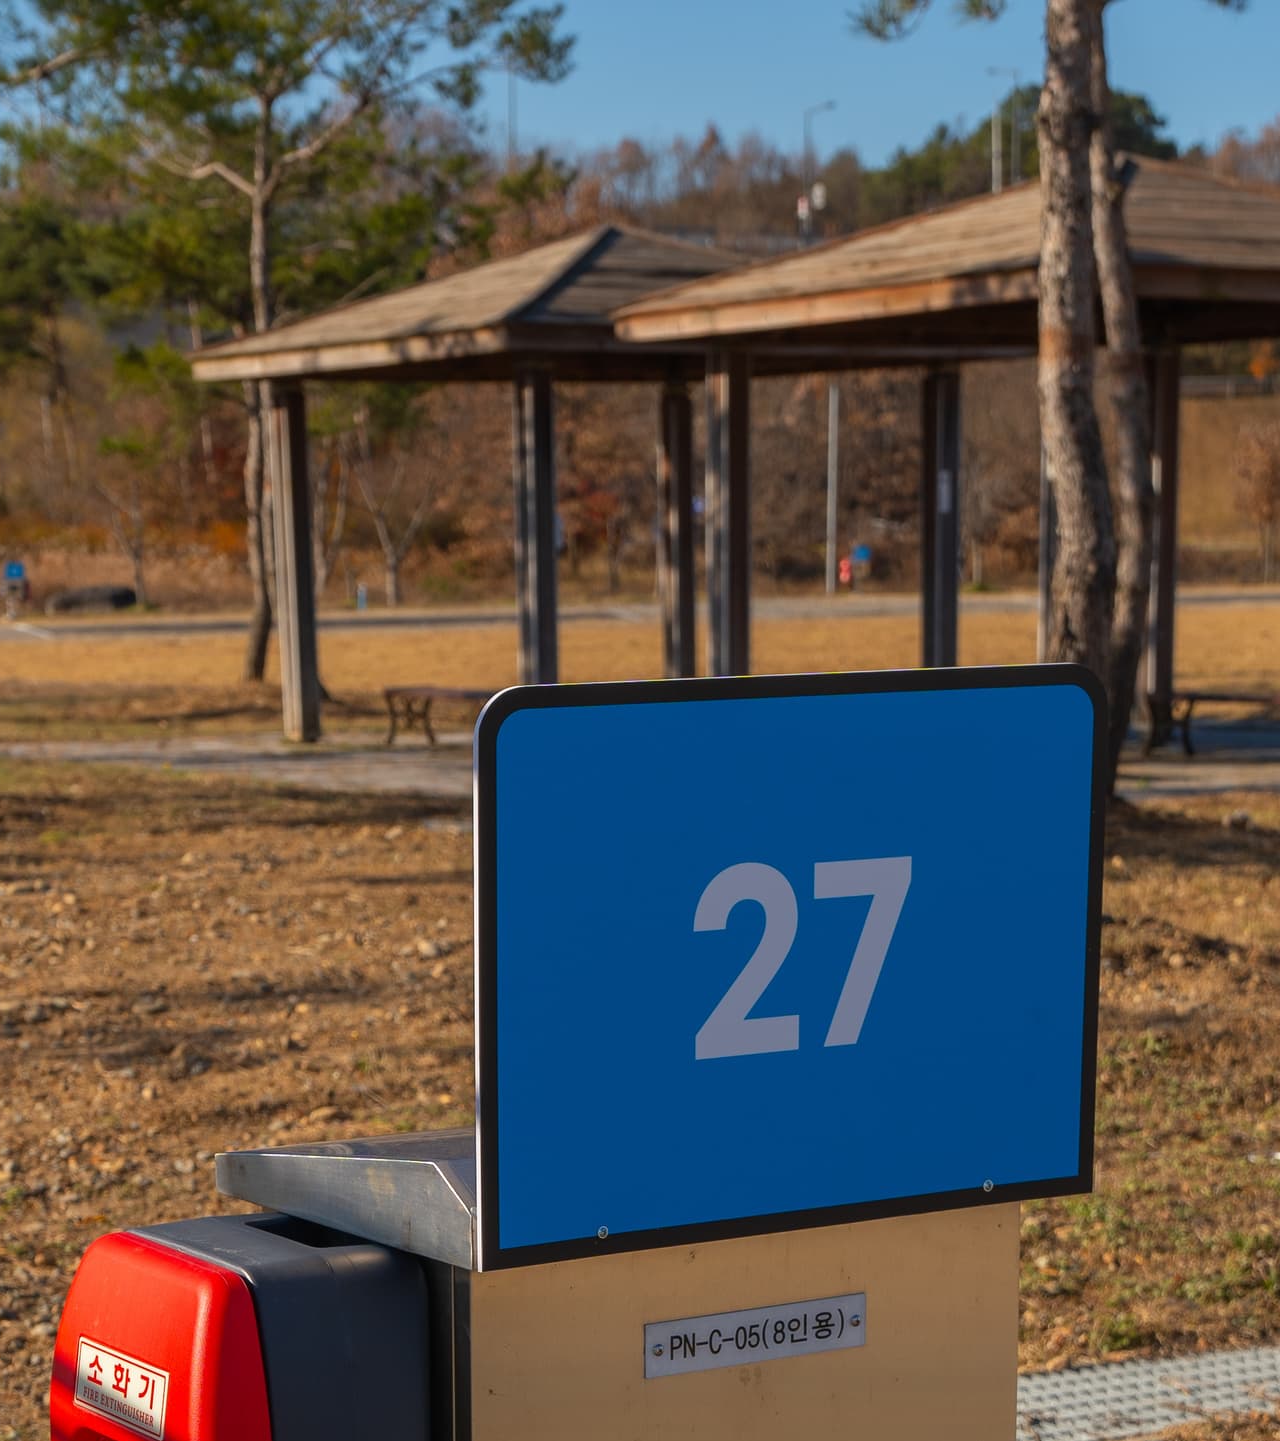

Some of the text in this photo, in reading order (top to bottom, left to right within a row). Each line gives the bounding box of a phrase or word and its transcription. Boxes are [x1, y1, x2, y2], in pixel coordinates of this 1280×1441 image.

[693, 856, 912, 1060] 27
[670, 1308, 845, 1360] PN-C-05(8인용)
[83, 1386, 154, 1427] FIRE EXTINGUISHER
[87, 1355, 156, 1410] 소화기
